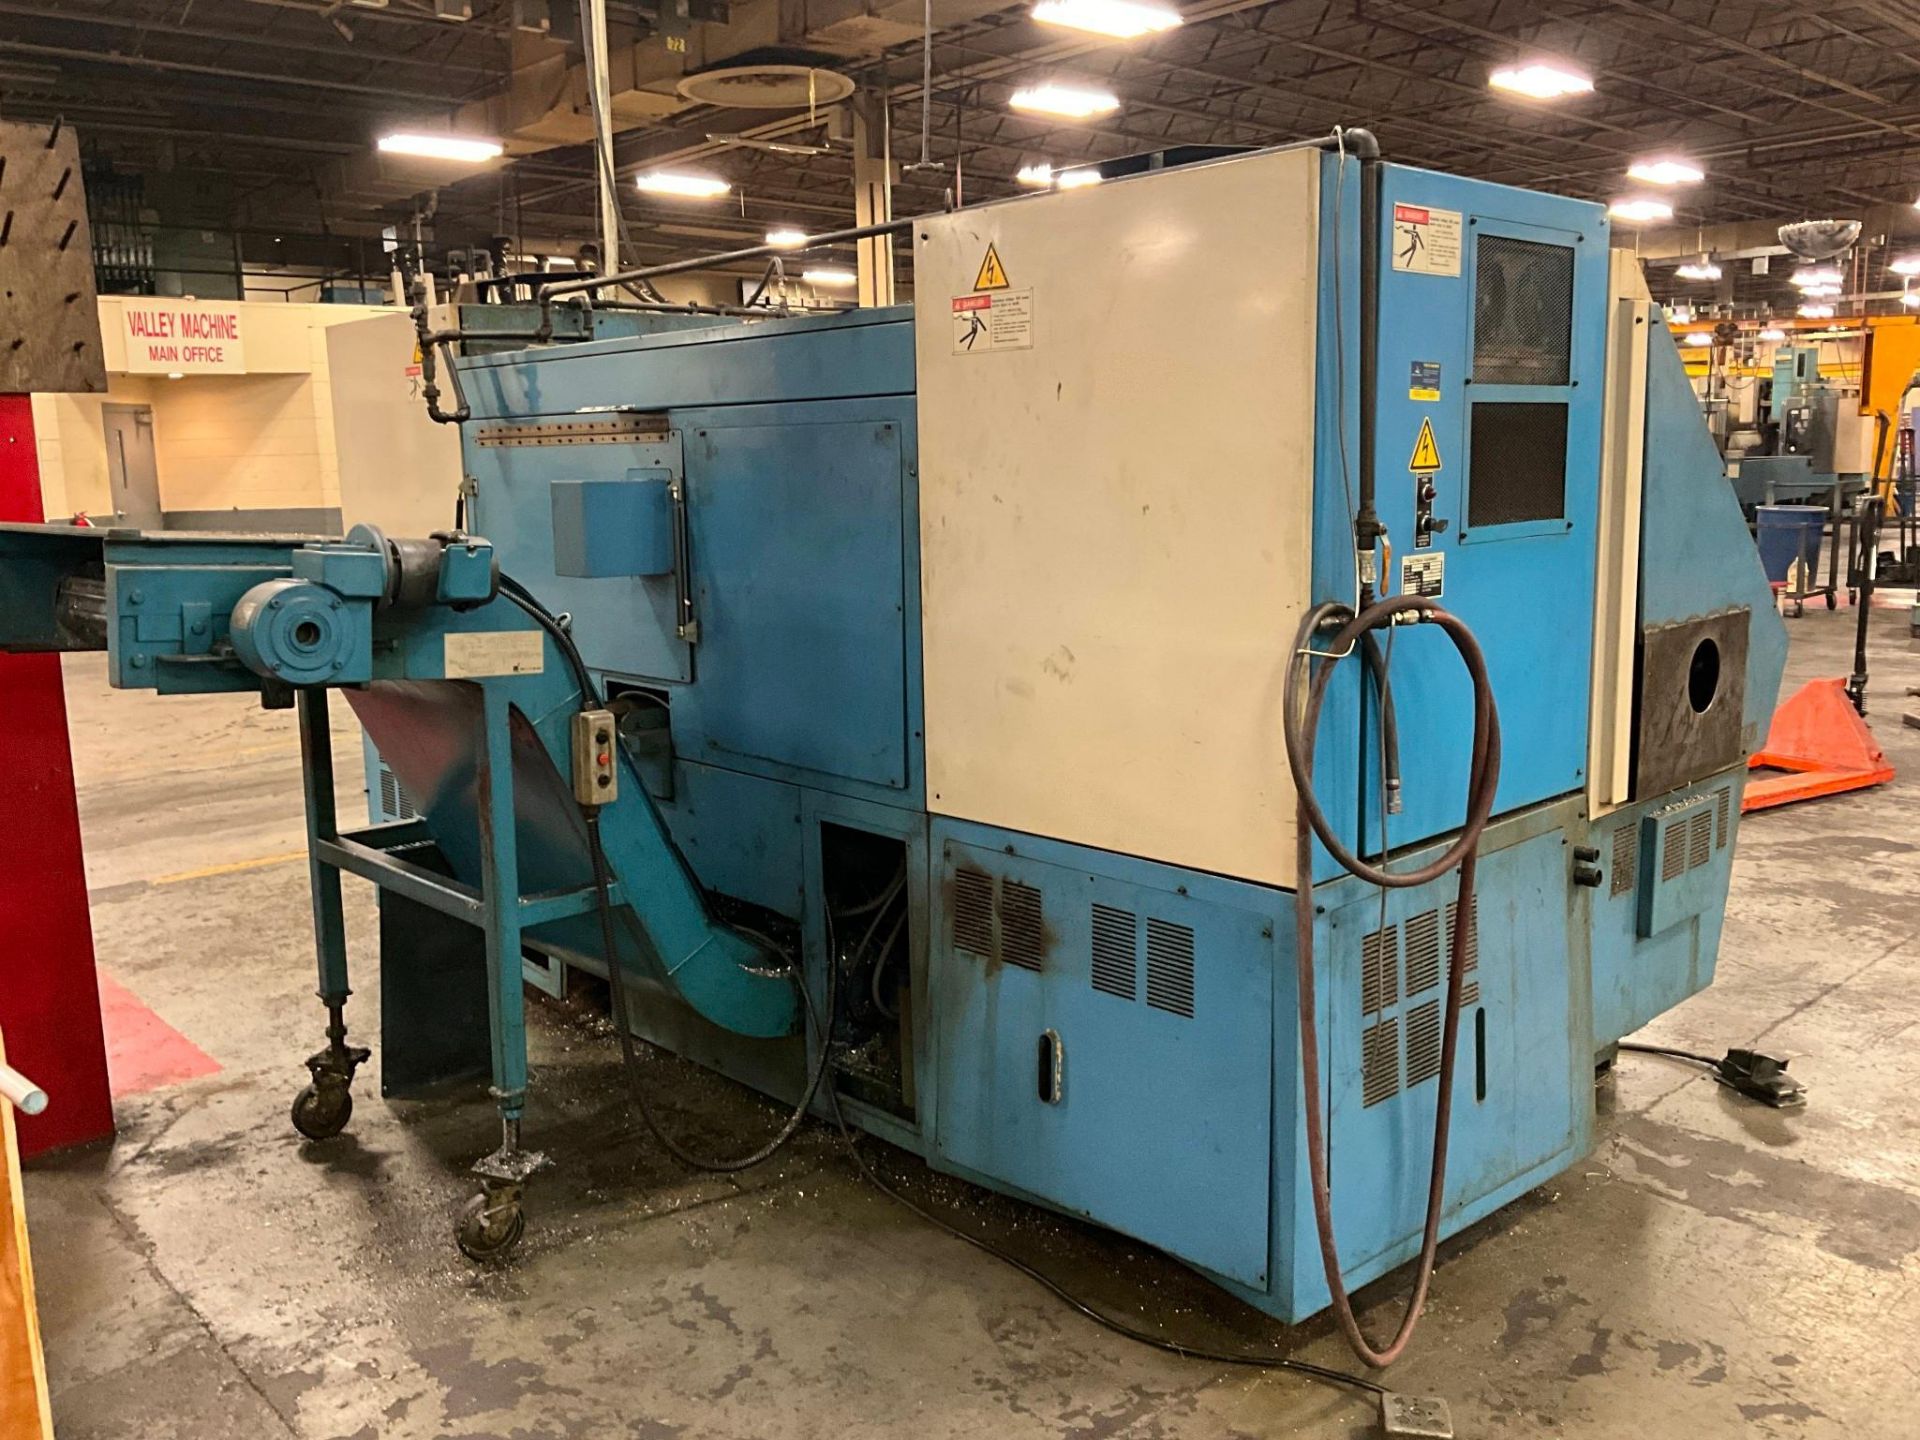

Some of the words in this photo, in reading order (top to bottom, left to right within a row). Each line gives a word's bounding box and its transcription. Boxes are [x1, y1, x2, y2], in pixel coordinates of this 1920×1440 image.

[127, 311, 175, 338] VALLEY
[180, 313, 238, 339] MACHINE
[149, 345, 178, 361] MAIN
[183, 346, 224, 362] OFFICE
